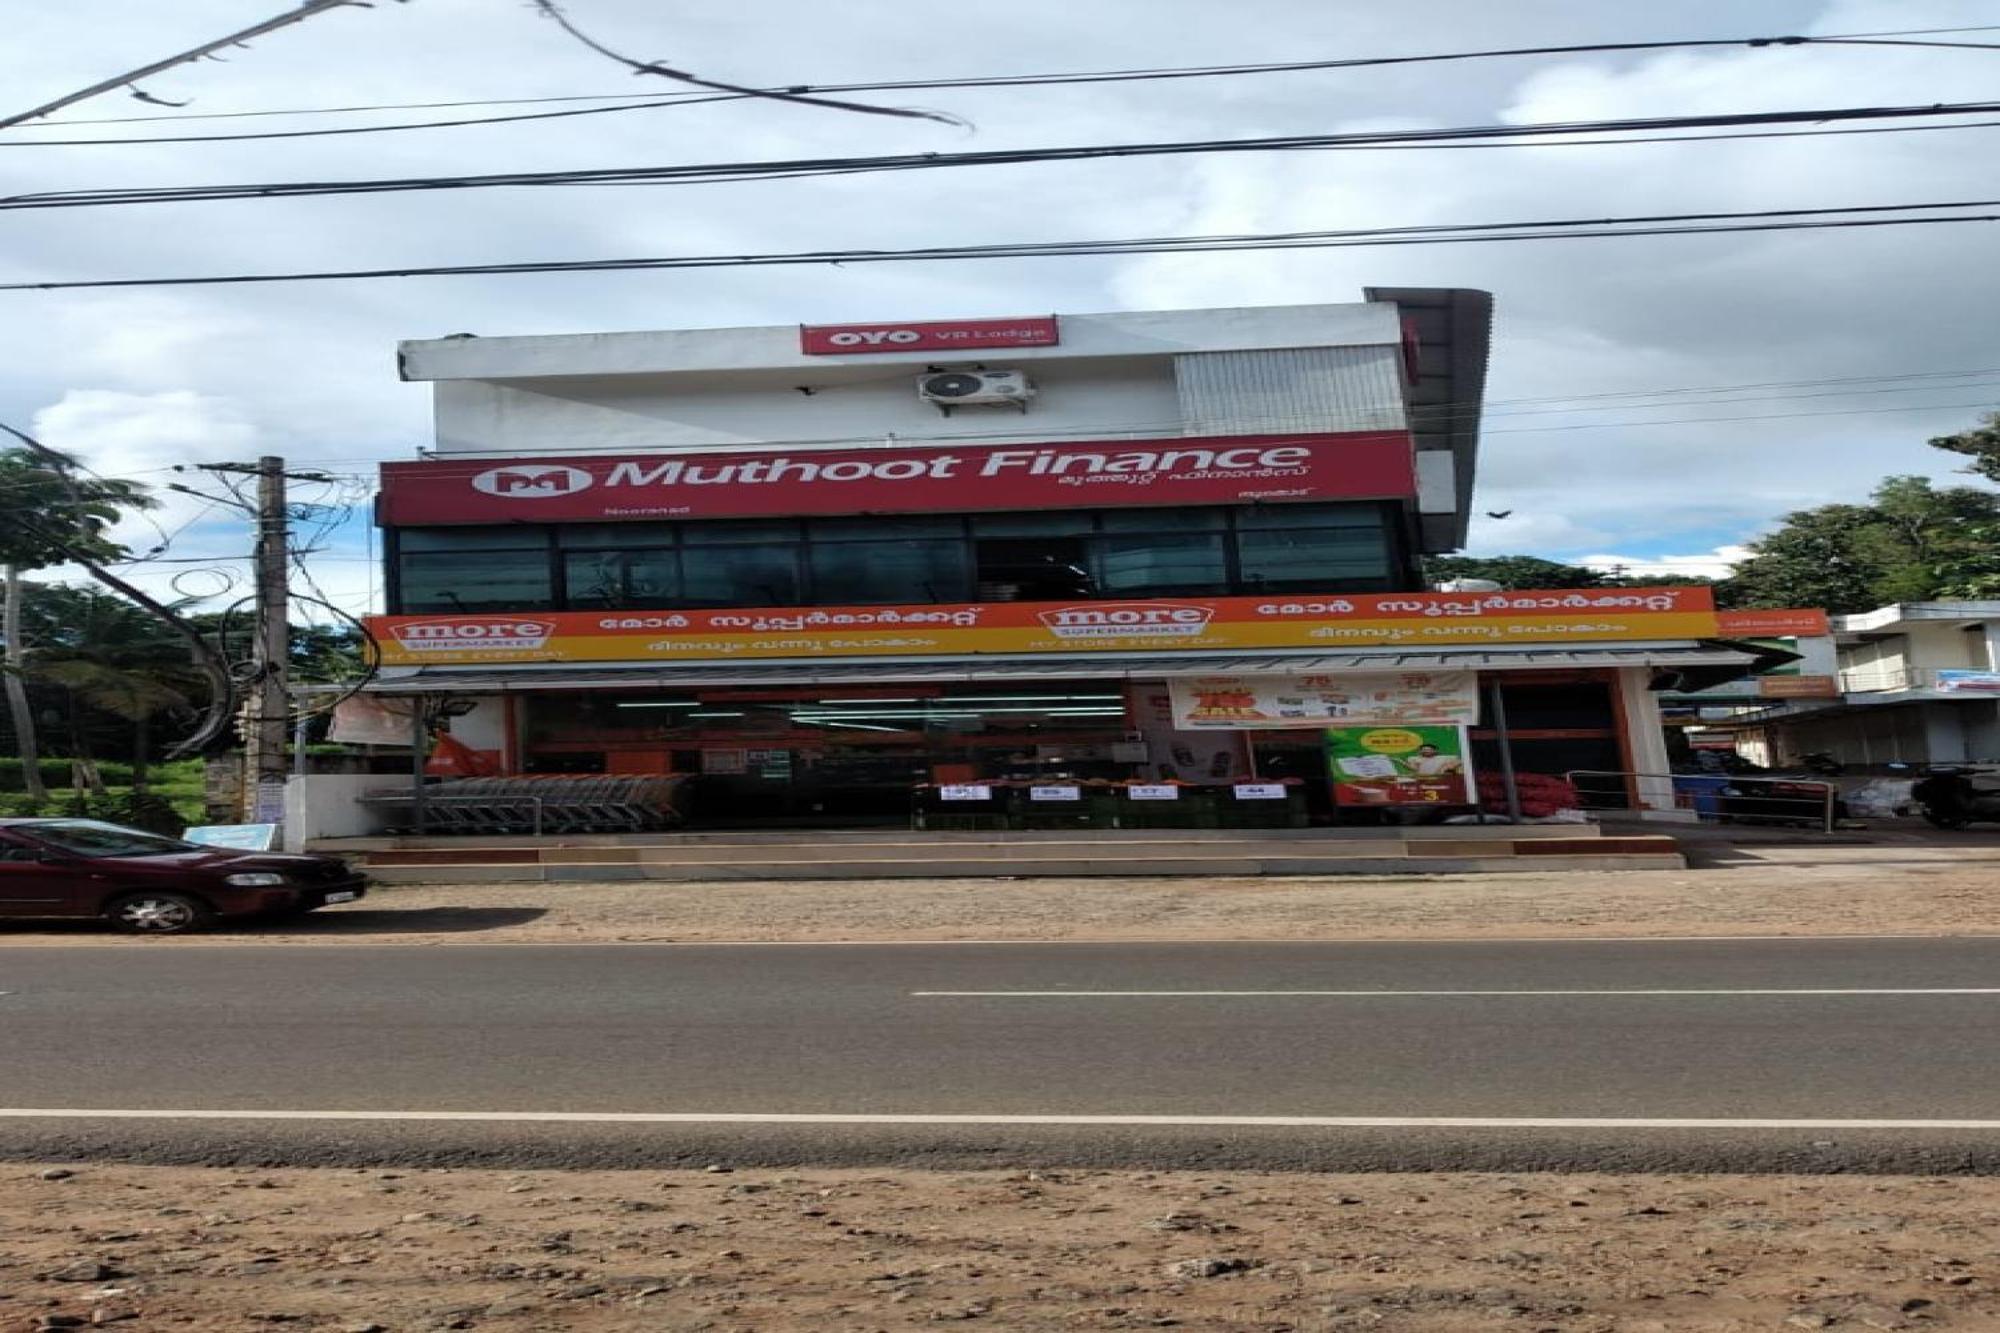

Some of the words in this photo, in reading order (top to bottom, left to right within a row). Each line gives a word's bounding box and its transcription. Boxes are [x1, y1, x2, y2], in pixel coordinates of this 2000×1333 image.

[830, 330, 920, 345] OYO
[935, 331, 968, 340] VR
[975, 328, 1046, 340] Lodge
[604, 455, 962, 487] Muthoot
[979, 447, 1311, 477] Finance
[1055, 609, 1202, 625] more
[405, 623, 543, 638] more
[1060, 626, 1194, 635] SUPERMARKET
[407, 639, 538, 649] SUPERMARKET
